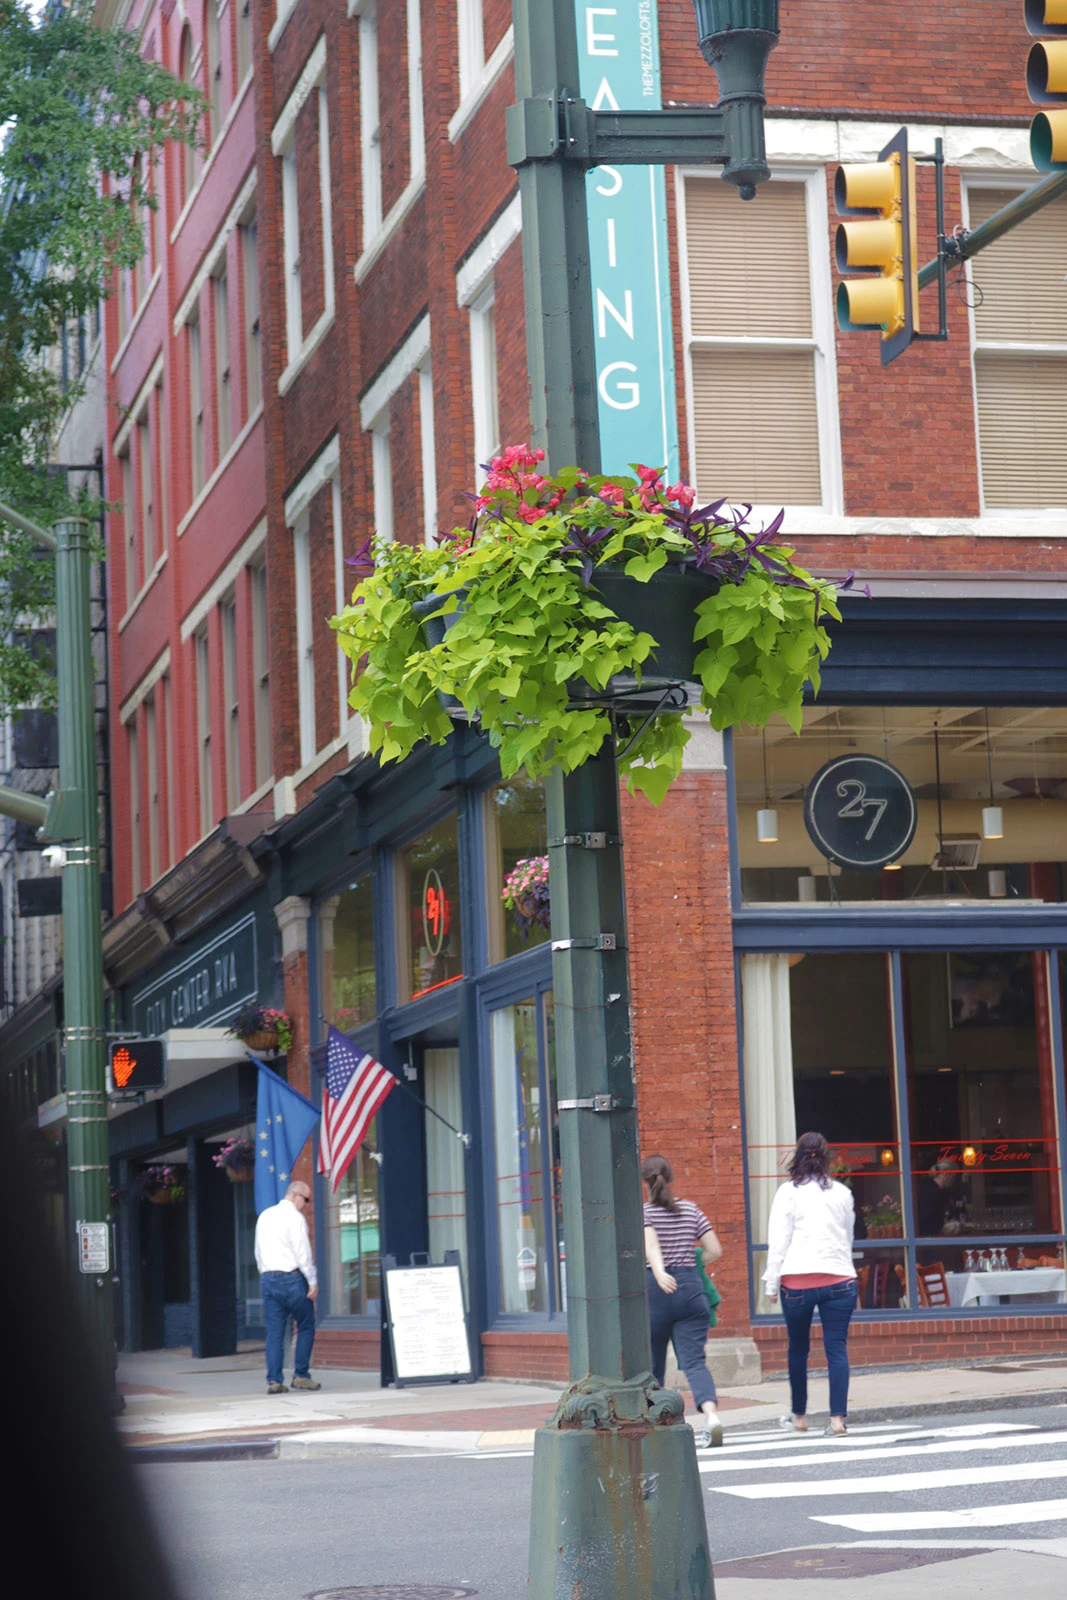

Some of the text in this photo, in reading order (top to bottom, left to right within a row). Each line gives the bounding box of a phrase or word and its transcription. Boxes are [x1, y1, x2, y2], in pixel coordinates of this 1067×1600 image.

[837, 779, 887, 840] 27
[171, 969, 210, 1026] CENTER
[937, 1144, 1031, 1167] Twety Seven
